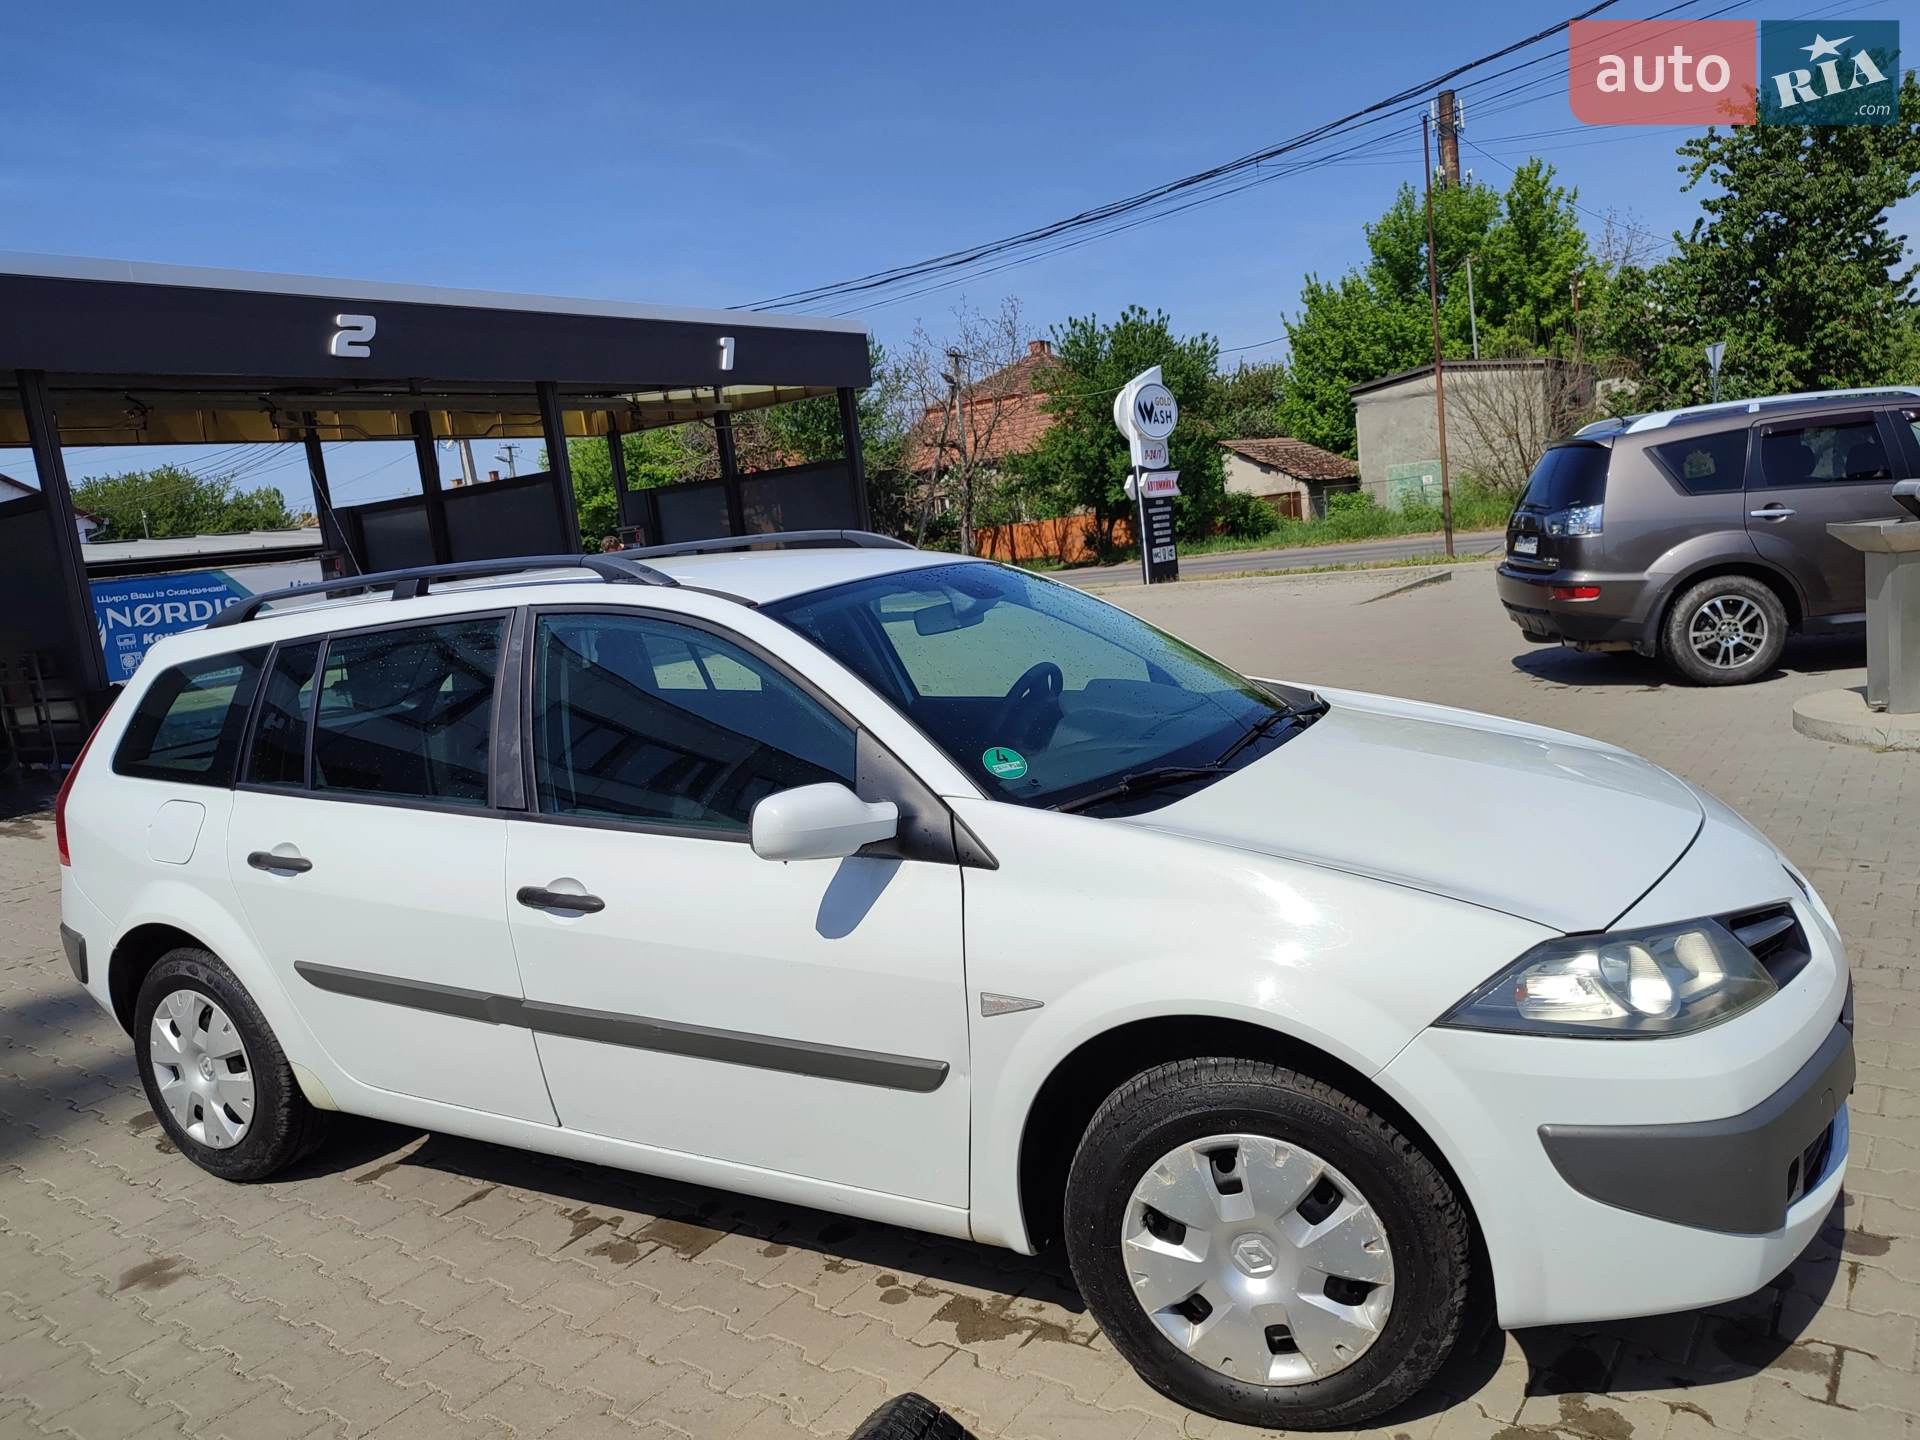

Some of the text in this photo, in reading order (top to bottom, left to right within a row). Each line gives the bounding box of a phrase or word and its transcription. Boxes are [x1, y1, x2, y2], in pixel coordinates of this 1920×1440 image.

[330, 313, 377, 358] 2
[719, 336, 735, 370] 1
[1154, 396, 1172, 406] GOLD
[1138, 400, 1173, 425] WASH
[1147, 478, 1176, 491] АВТОМИЙКА
[96, 595, 129, 604] Щиро
[130, 592, 155, 600] Ваш
[166, 584, 227, 597] Скандинавії
[995, 749, 1009, 762] 4
